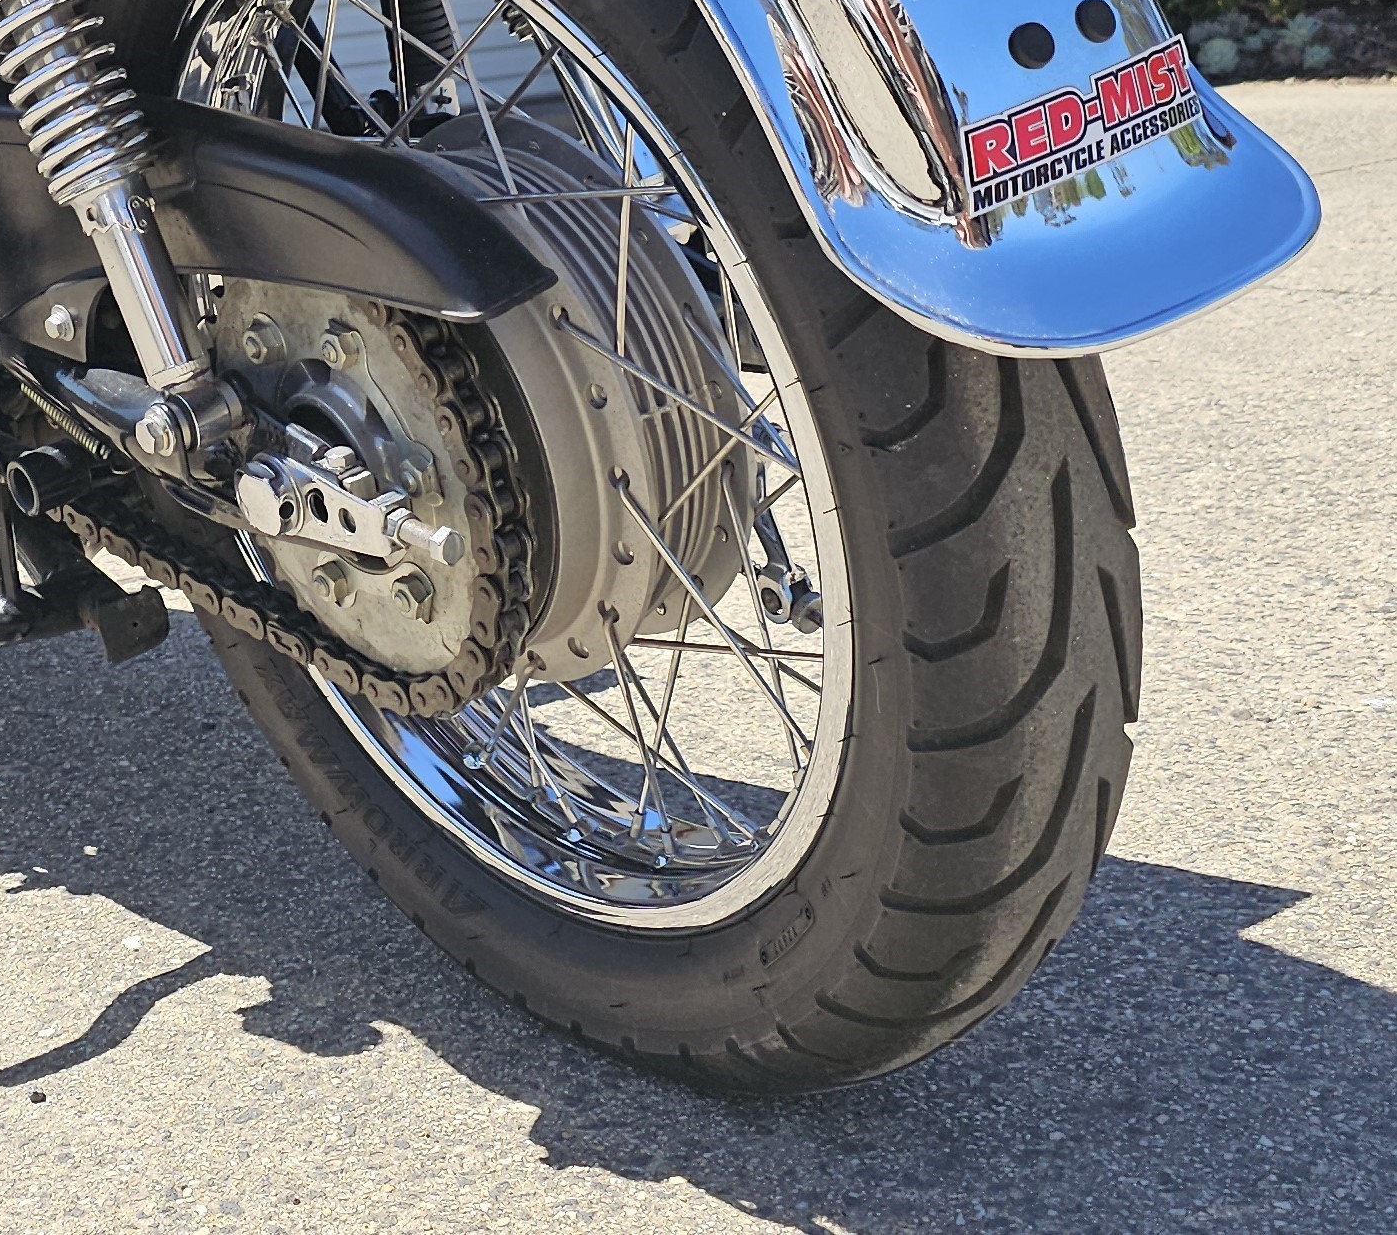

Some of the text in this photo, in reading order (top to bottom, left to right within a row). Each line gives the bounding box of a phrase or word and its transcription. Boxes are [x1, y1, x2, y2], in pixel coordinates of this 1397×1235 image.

[967, 42, 1191, 181] RED-MIST
[973, 96, 1201, 213] MOTORCYCLE ACCESSORIES
